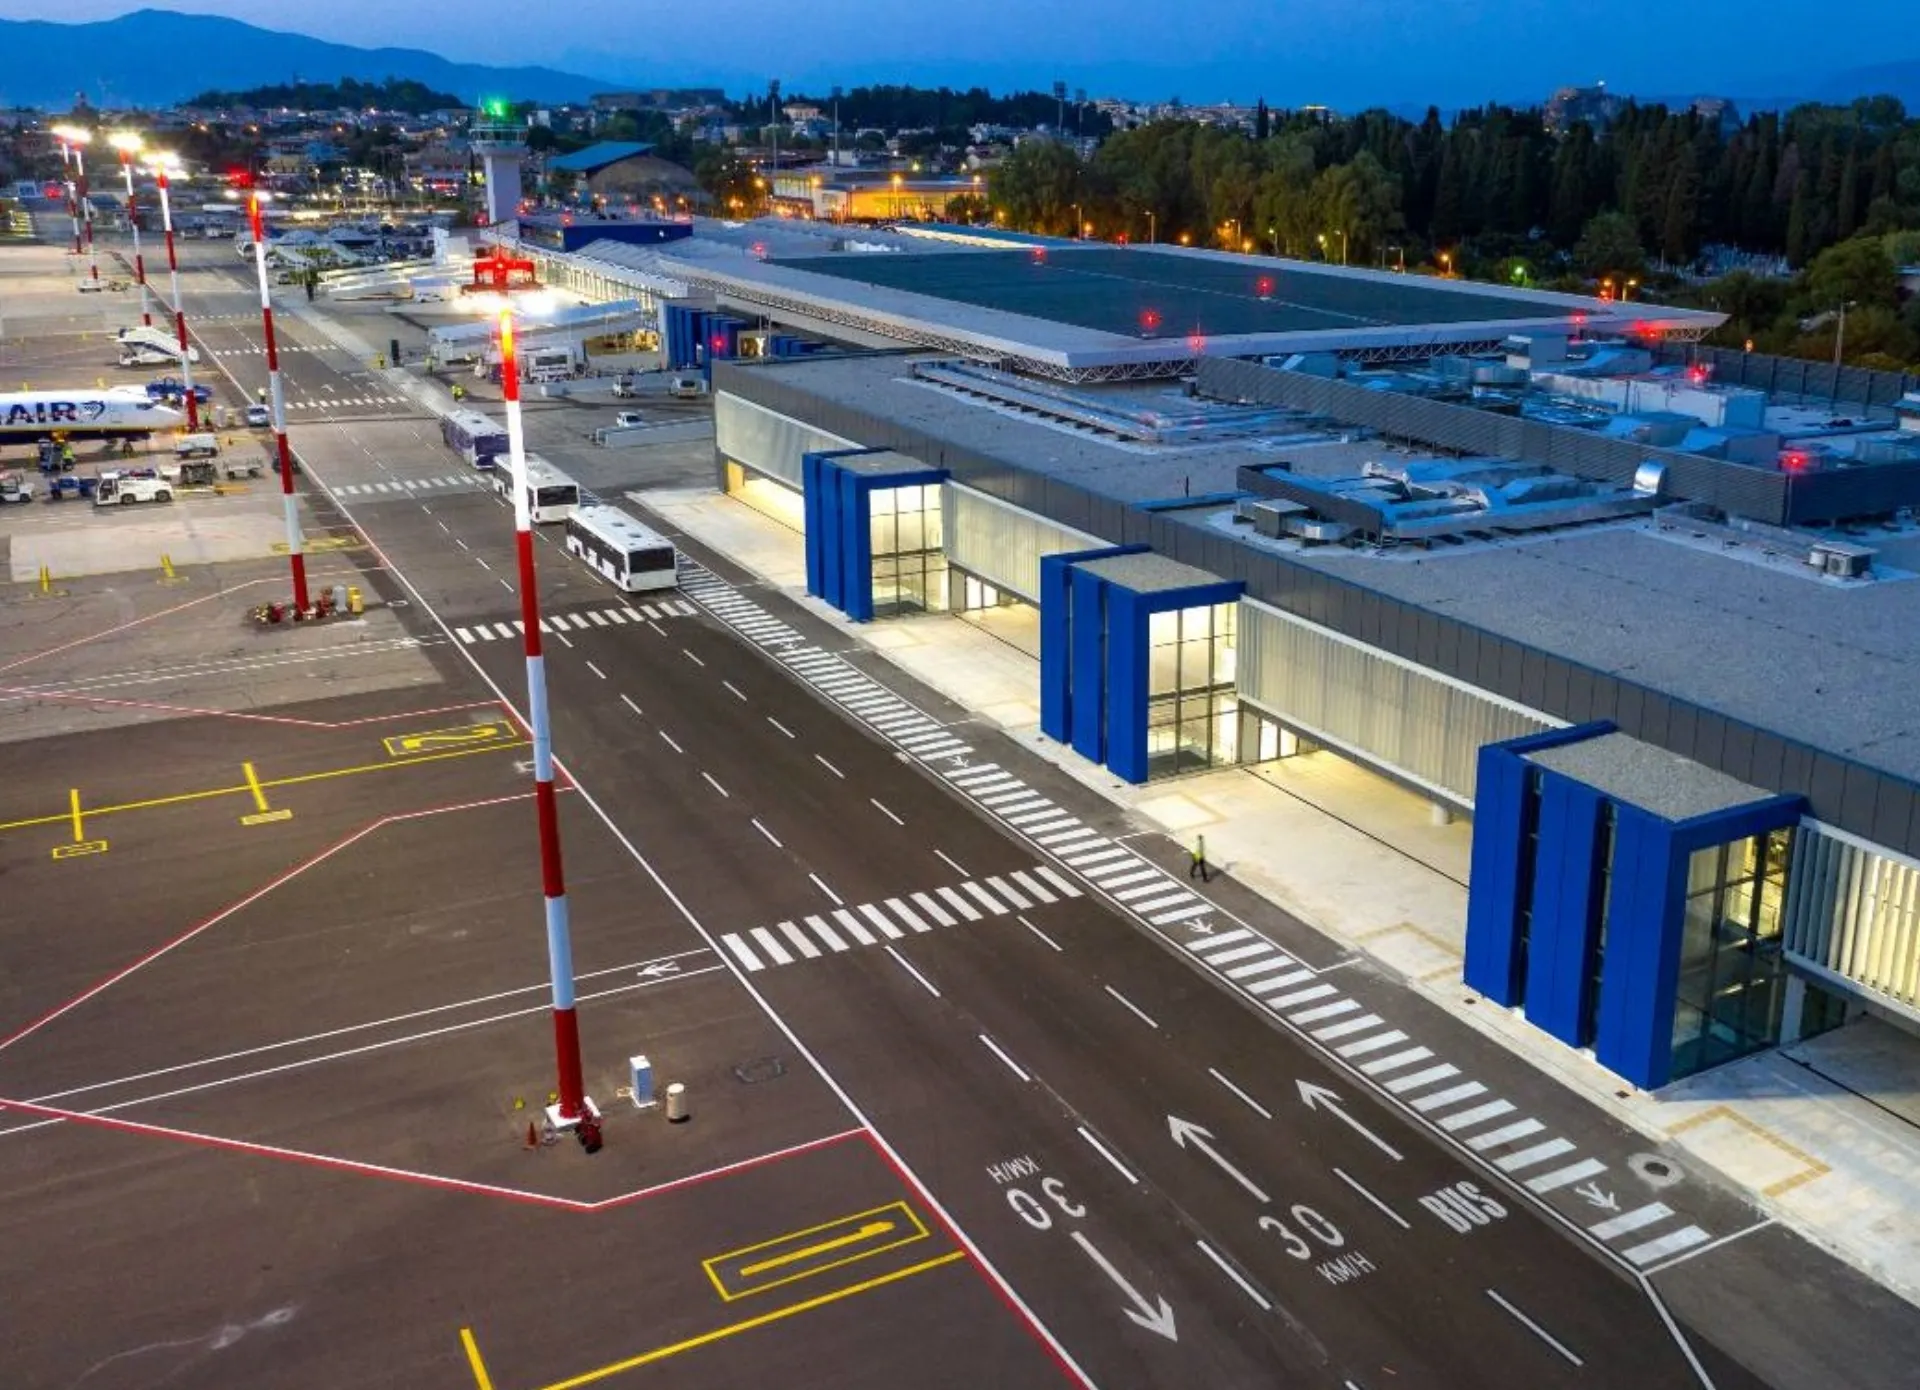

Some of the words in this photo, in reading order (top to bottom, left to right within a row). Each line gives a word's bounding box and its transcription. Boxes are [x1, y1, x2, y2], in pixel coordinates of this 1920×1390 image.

[0, 402, 77, 425] AIR
[987, 1155, 1042, 1184] KM/H
[1007, 1177, 1086, 1230] 30
[1418, 1181, 1508, 1233] BUS
[1258, 1204, 1344, 1259] 30
[1316, 1249, 1377, 1285] KM/H
